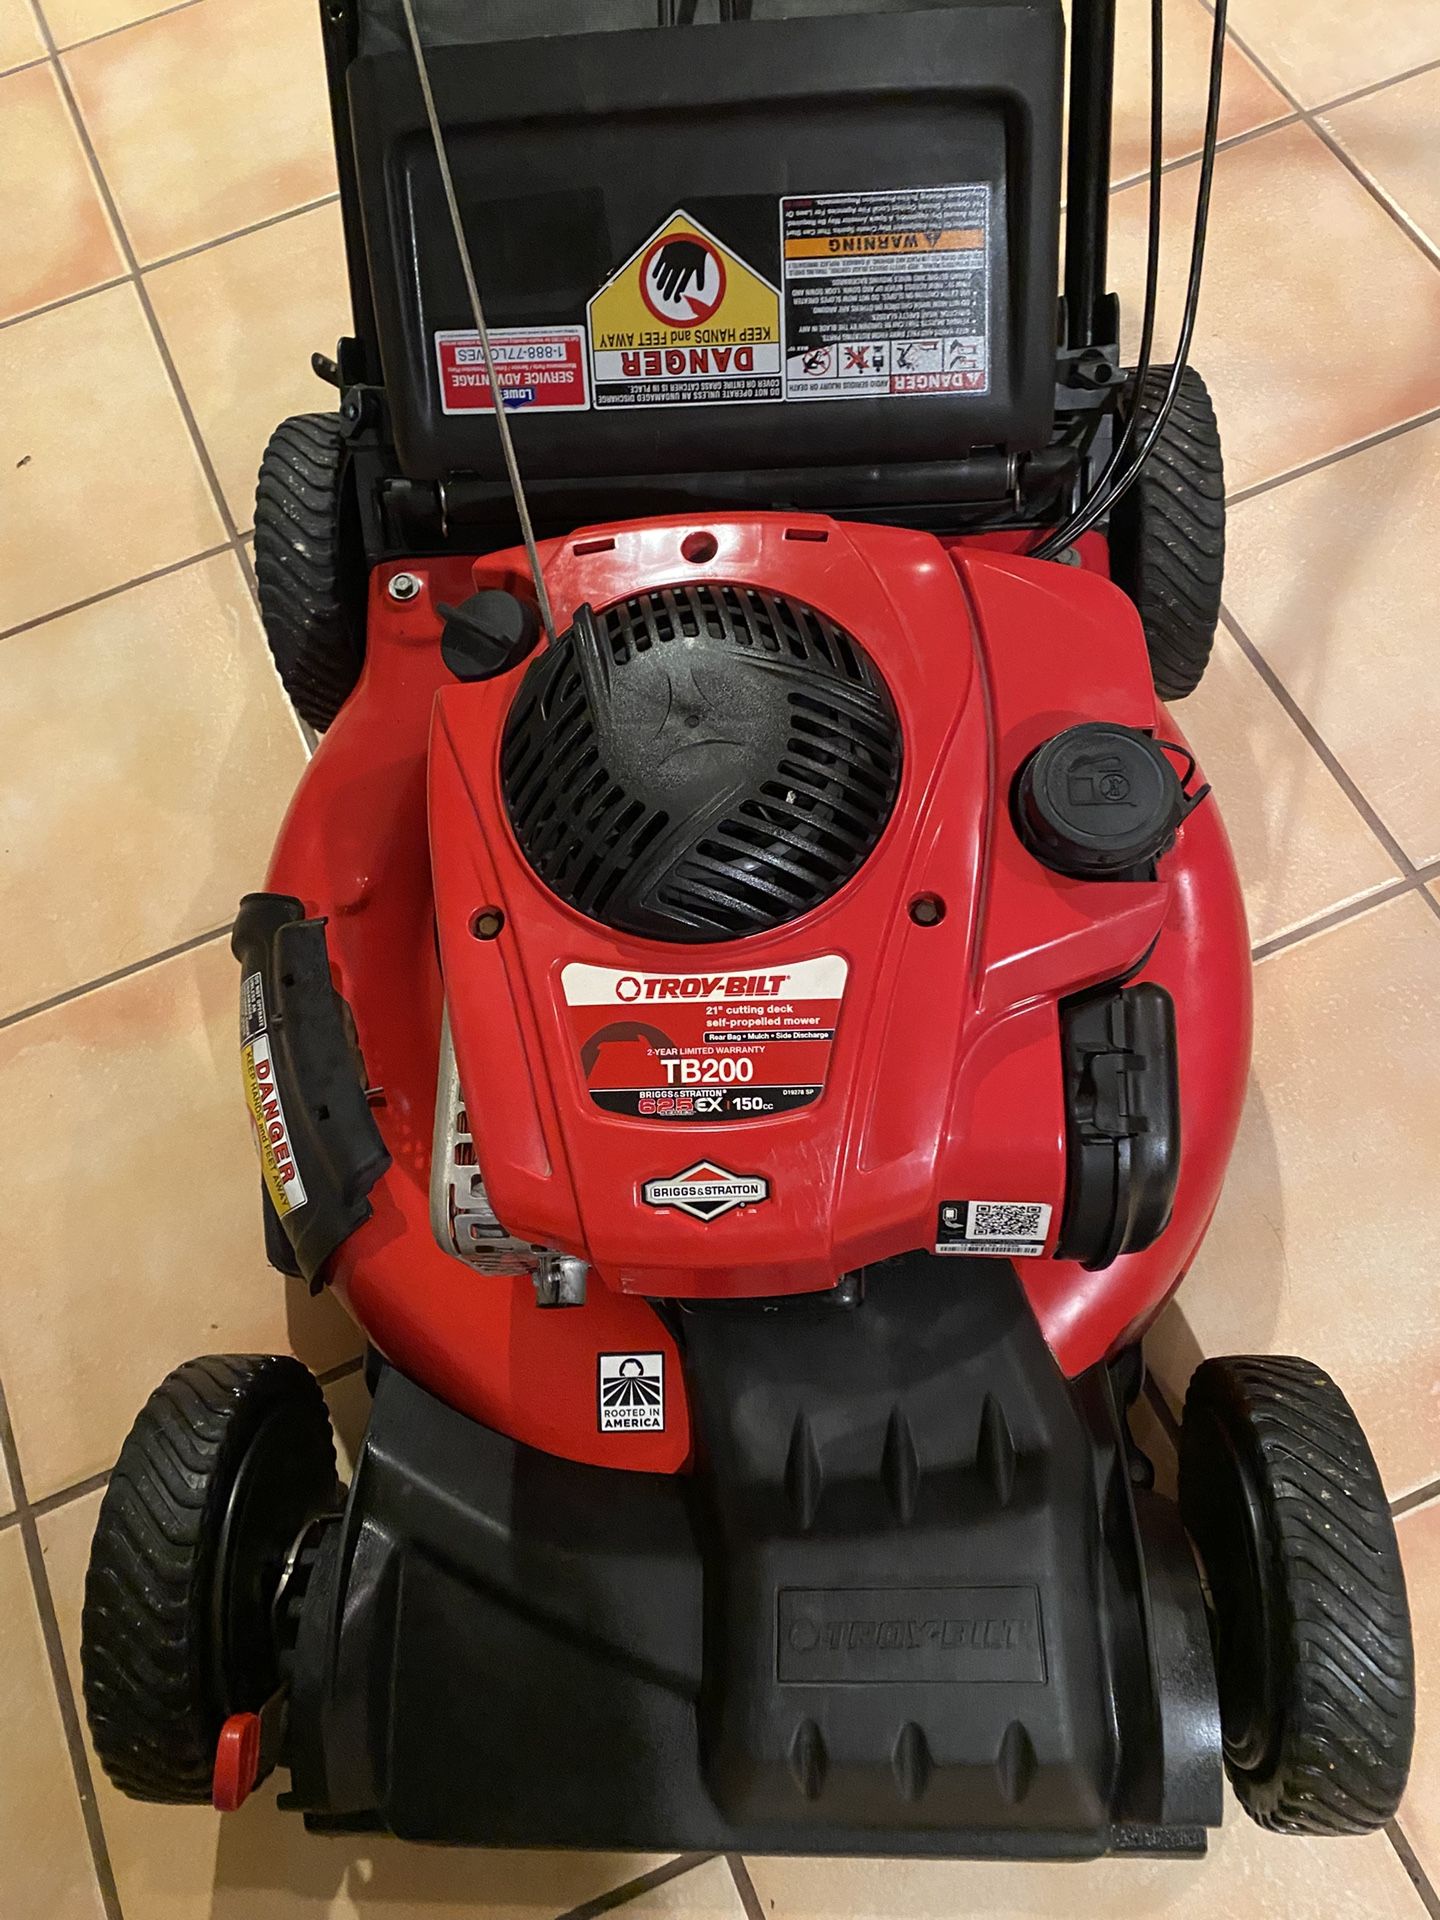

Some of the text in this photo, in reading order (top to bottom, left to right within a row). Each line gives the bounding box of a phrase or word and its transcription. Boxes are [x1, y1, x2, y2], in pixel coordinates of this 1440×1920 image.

[814, 208, 825, 216] For
[816, 227, 831, 235] That
[828, 234, 918, 252] WARNING
[811, 324, 817, 332] IN
[598, 326, 771, 347] KEEP HANDS and FEET AWAY
[620, 346, 753, 376] DANGER
[451, 370, 574, 387] SERVICE ADVNTAGE
[627, 378, 779, 393] COVER OR ENTIRE GRASS CATCHER IS IN PLACE.
[820, 382, 840, 390] INJURY
[843, 381, 868, 389] SERIOUS
[895, 372, 962, 389] DANGER
[597, 387, 779, 402] DO NOT OPERATE UNLESS AN UNDAMAGED DISCHARGE
[789, 383, 807, 391] DEATH
[643, 975, 786, 999] TROY-BILT
[706, 1005, 793, 1016] 21" cutting deck
[706, 1017, 820, 1028] self-propelled mower
[727, 1034, 742, 1042] Bag
[793, 1032, 828, 1041] Discharge
[647, 1046, 765, 1056] 2-YEAR LIMITED WARRANTY
[244, 1051, 256, 1081] KEEP
[660, 1058, 753, 1083] TB200
[249, 1081, 264, 1122] HANDS
[255, 1059, 296, 1184] DANGER
[258, 1121, 268, 1143] and
[272, 1171, 287, 1210] AWAY
[653, 1185, 759, 1197] BRIGGS&STRATTON
[604, 1408, 660, 1417] ROOTED IN
[604, 1418, 661, 1428] AMERICA
[826, 1618, 1028, 1651] TROY-BILT
